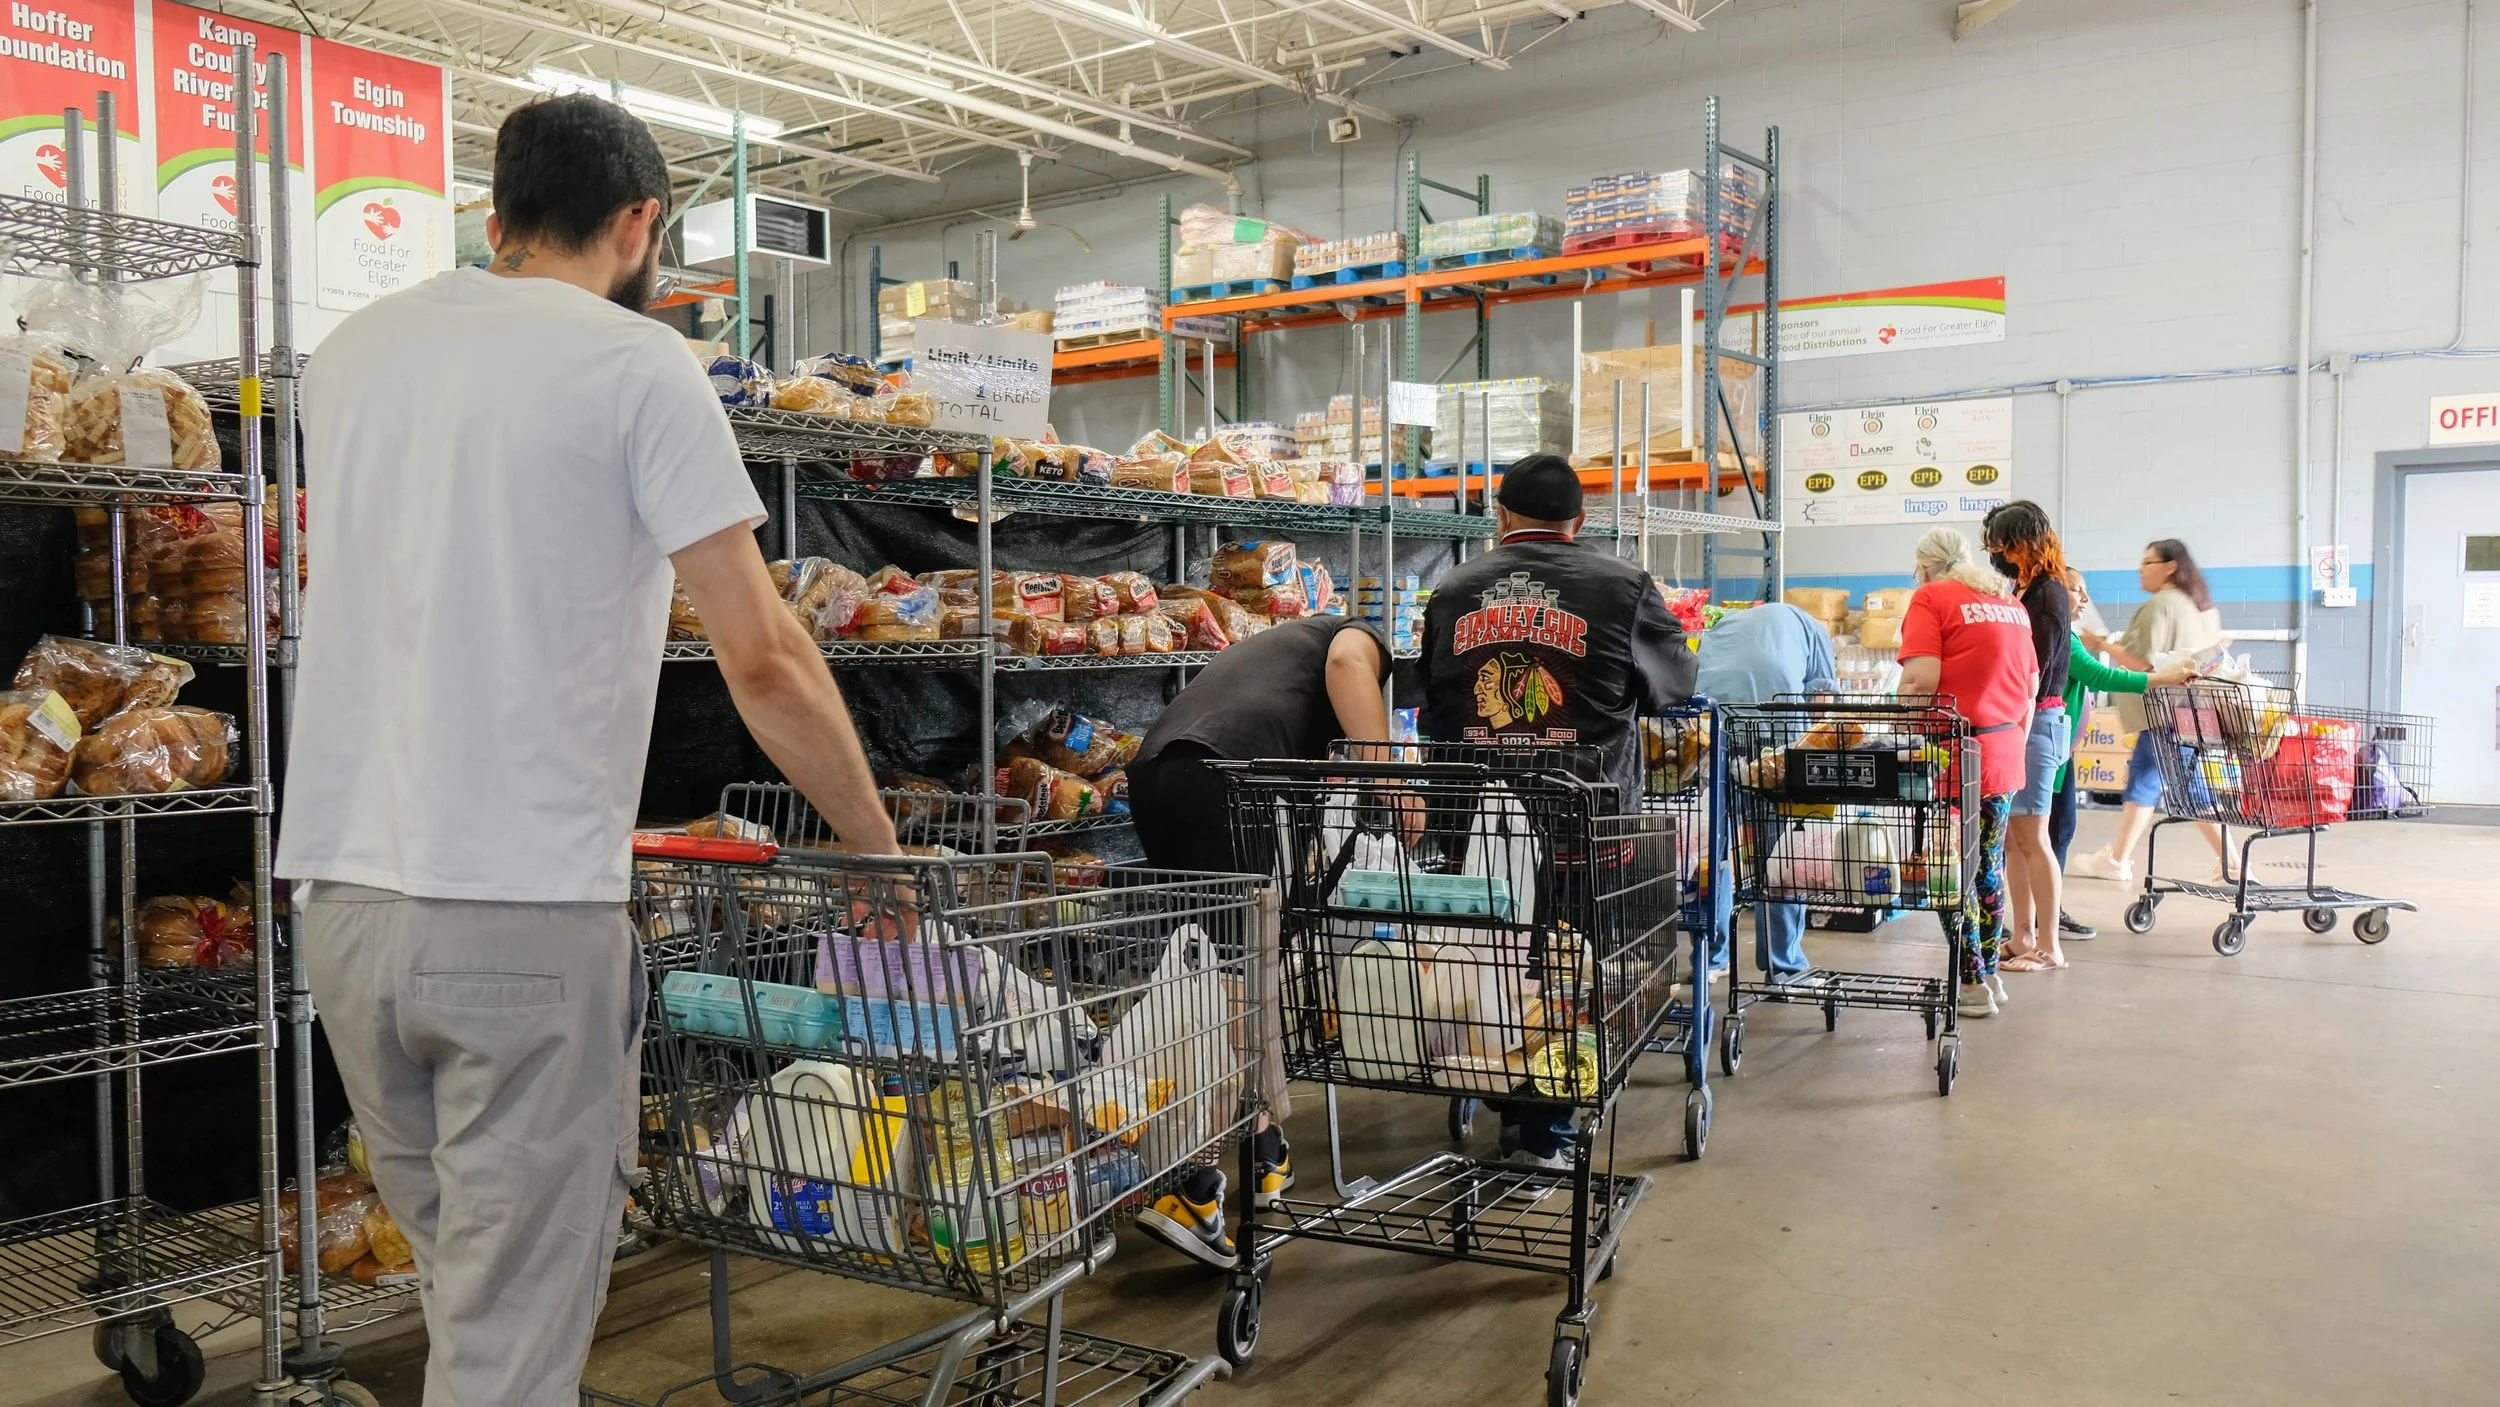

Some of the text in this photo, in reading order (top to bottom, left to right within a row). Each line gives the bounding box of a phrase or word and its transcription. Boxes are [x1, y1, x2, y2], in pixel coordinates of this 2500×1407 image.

[11, 2, 94, 42] Hoffer
[199, 15, 257, 48] Kane
[0, 35, 126, 80] oundation
[188, 43, 267, 86] Couy
[353, 76, 405, 108] Elgin
[331, 100, 426, 145] Township
[23, 185, 65, 204] Food
[353, 238, 411, 258] Food For
[358, 255, 408, 273] Greater
[368, 271, 400, 289] Elgin
[1801, 330, 1810, 340] of
[1812, 330, 1826, 339] our
[1829, 325, 1861, 336] annual
[1900, 318, 1997, 335] Food For Greater Elgin
[1803, 337, 1868, 351] Distributions
[928, 348, 970, 365] Limit
[993, 389, 1041, 404] BREAD
[939, 401, 1004, 422] TOTAL
[1809, 405, 1939, 423] Elgin Elgin Elgin
[2440, 406, 2497, 430] OFFI
[1860, 446, 1894, 455] LAMP
[1039, 465, 1064, 477] KETO
[1808, 468, 1996, 489] EPH EPH EPH EPH
[1904, 498, 1948, 516] imago
[1959, 496, 2004, 514] imago
[1520, 598, 1550, 608] TIME
[1455, 605, 1587, 638] STANLEY CUP
[1453, 626, 1587, 658] CHAMPIONS
[1549, 730, 1573, 740] 2010
[2083, 729, 2115, 748] yffes
